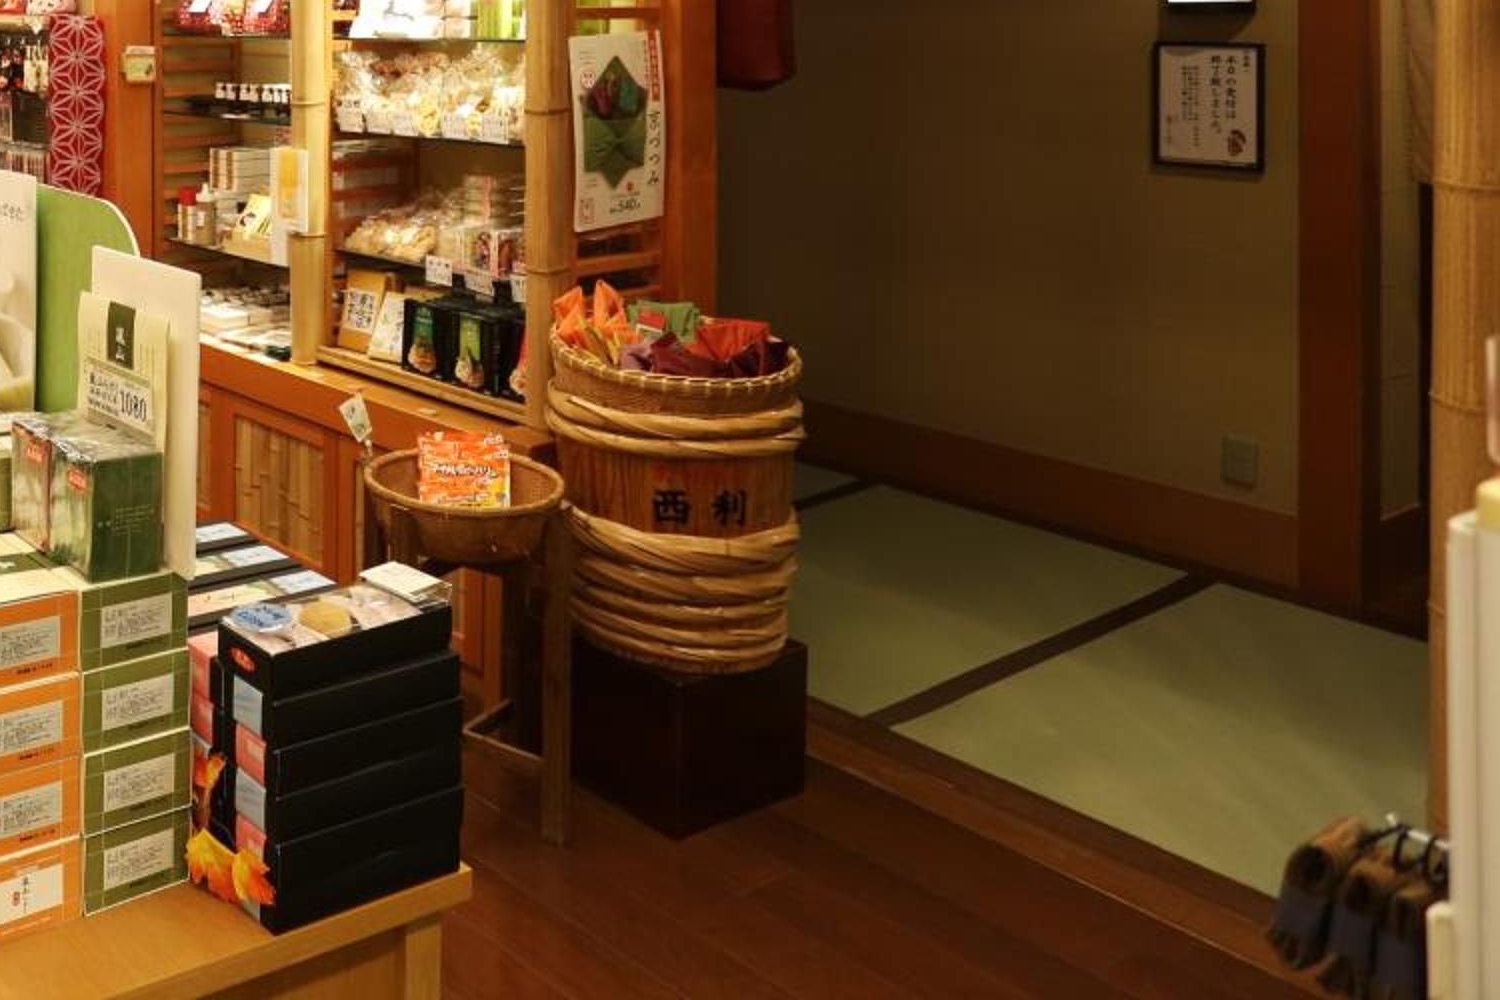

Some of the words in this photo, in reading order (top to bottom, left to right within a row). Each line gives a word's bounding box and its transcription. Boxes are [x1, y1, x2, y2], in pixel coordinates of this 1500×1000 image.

[645, 108, 661, 185] 京つつみ
[120, 390, 147, 422] 1080
[653, 488, 747, 526] 西利
